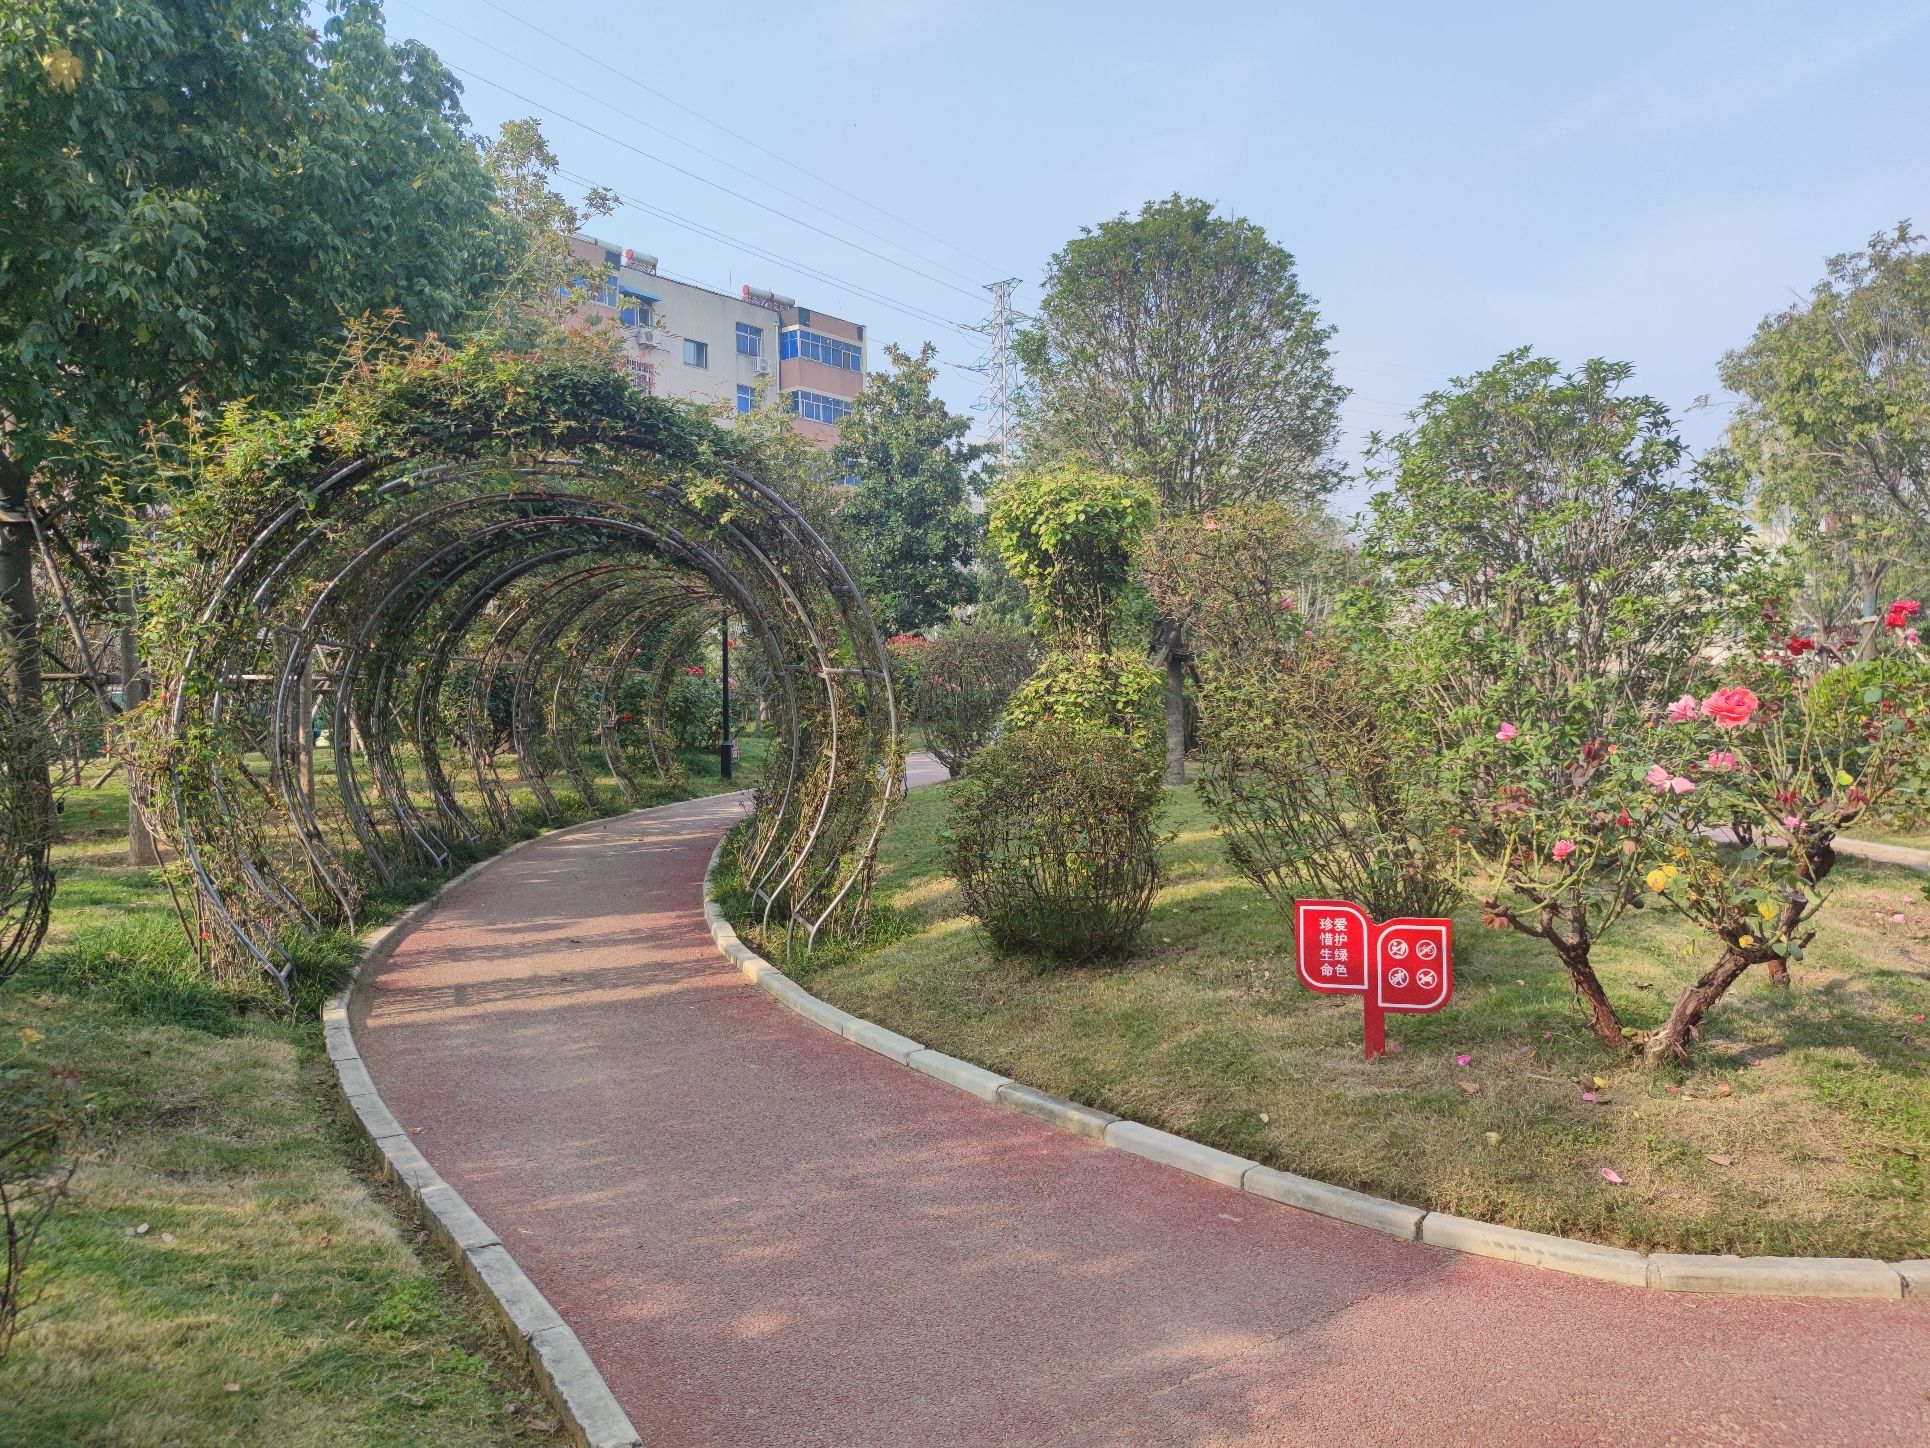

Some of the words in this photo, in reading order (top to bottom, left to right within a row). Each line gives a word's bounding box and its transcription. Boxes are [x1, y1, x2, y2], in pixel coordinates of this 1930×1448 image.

[1319, 917, 1333, 976] 珍惜生命
[1334, 917, 1348, 977] 爱护绿色
